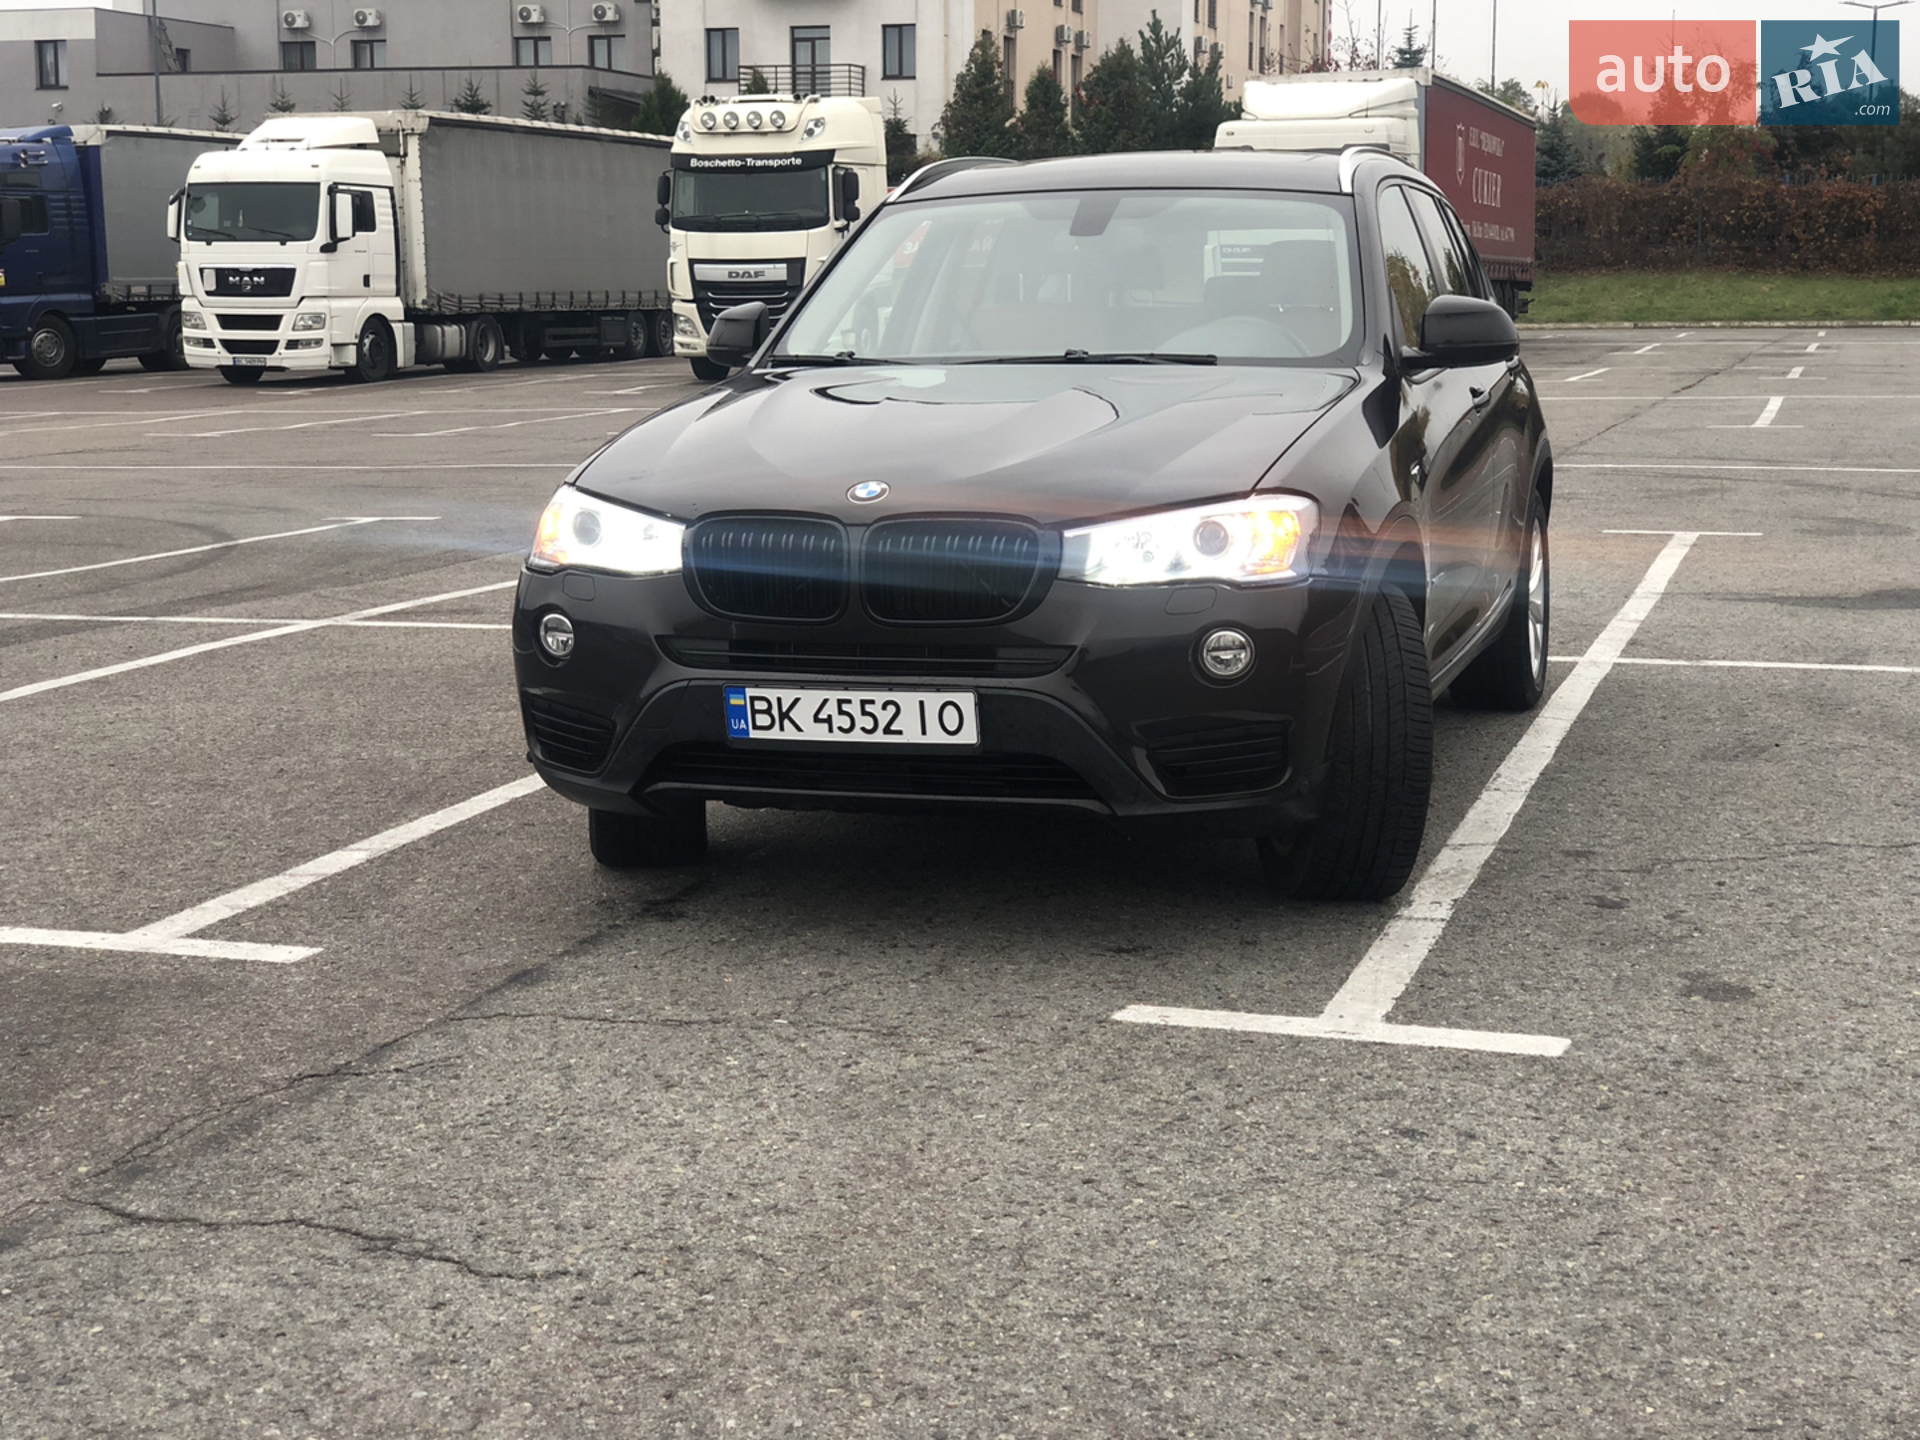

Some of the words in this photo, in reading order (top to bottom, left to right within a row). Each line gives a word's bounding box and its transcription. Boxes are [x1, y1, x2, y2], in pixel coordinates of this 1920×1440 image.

[690, 156, 802, 168] Boschetto-Transporte
[1472, 167, 1502, 208] CUKIER
[228, 276, 265, 285] MAN
[727, 270, 766, 279] DAF
[748, 695, 804, 732] BK
[812, 697, 904, 736] 4552
[731, 718, 747, 730] UA
